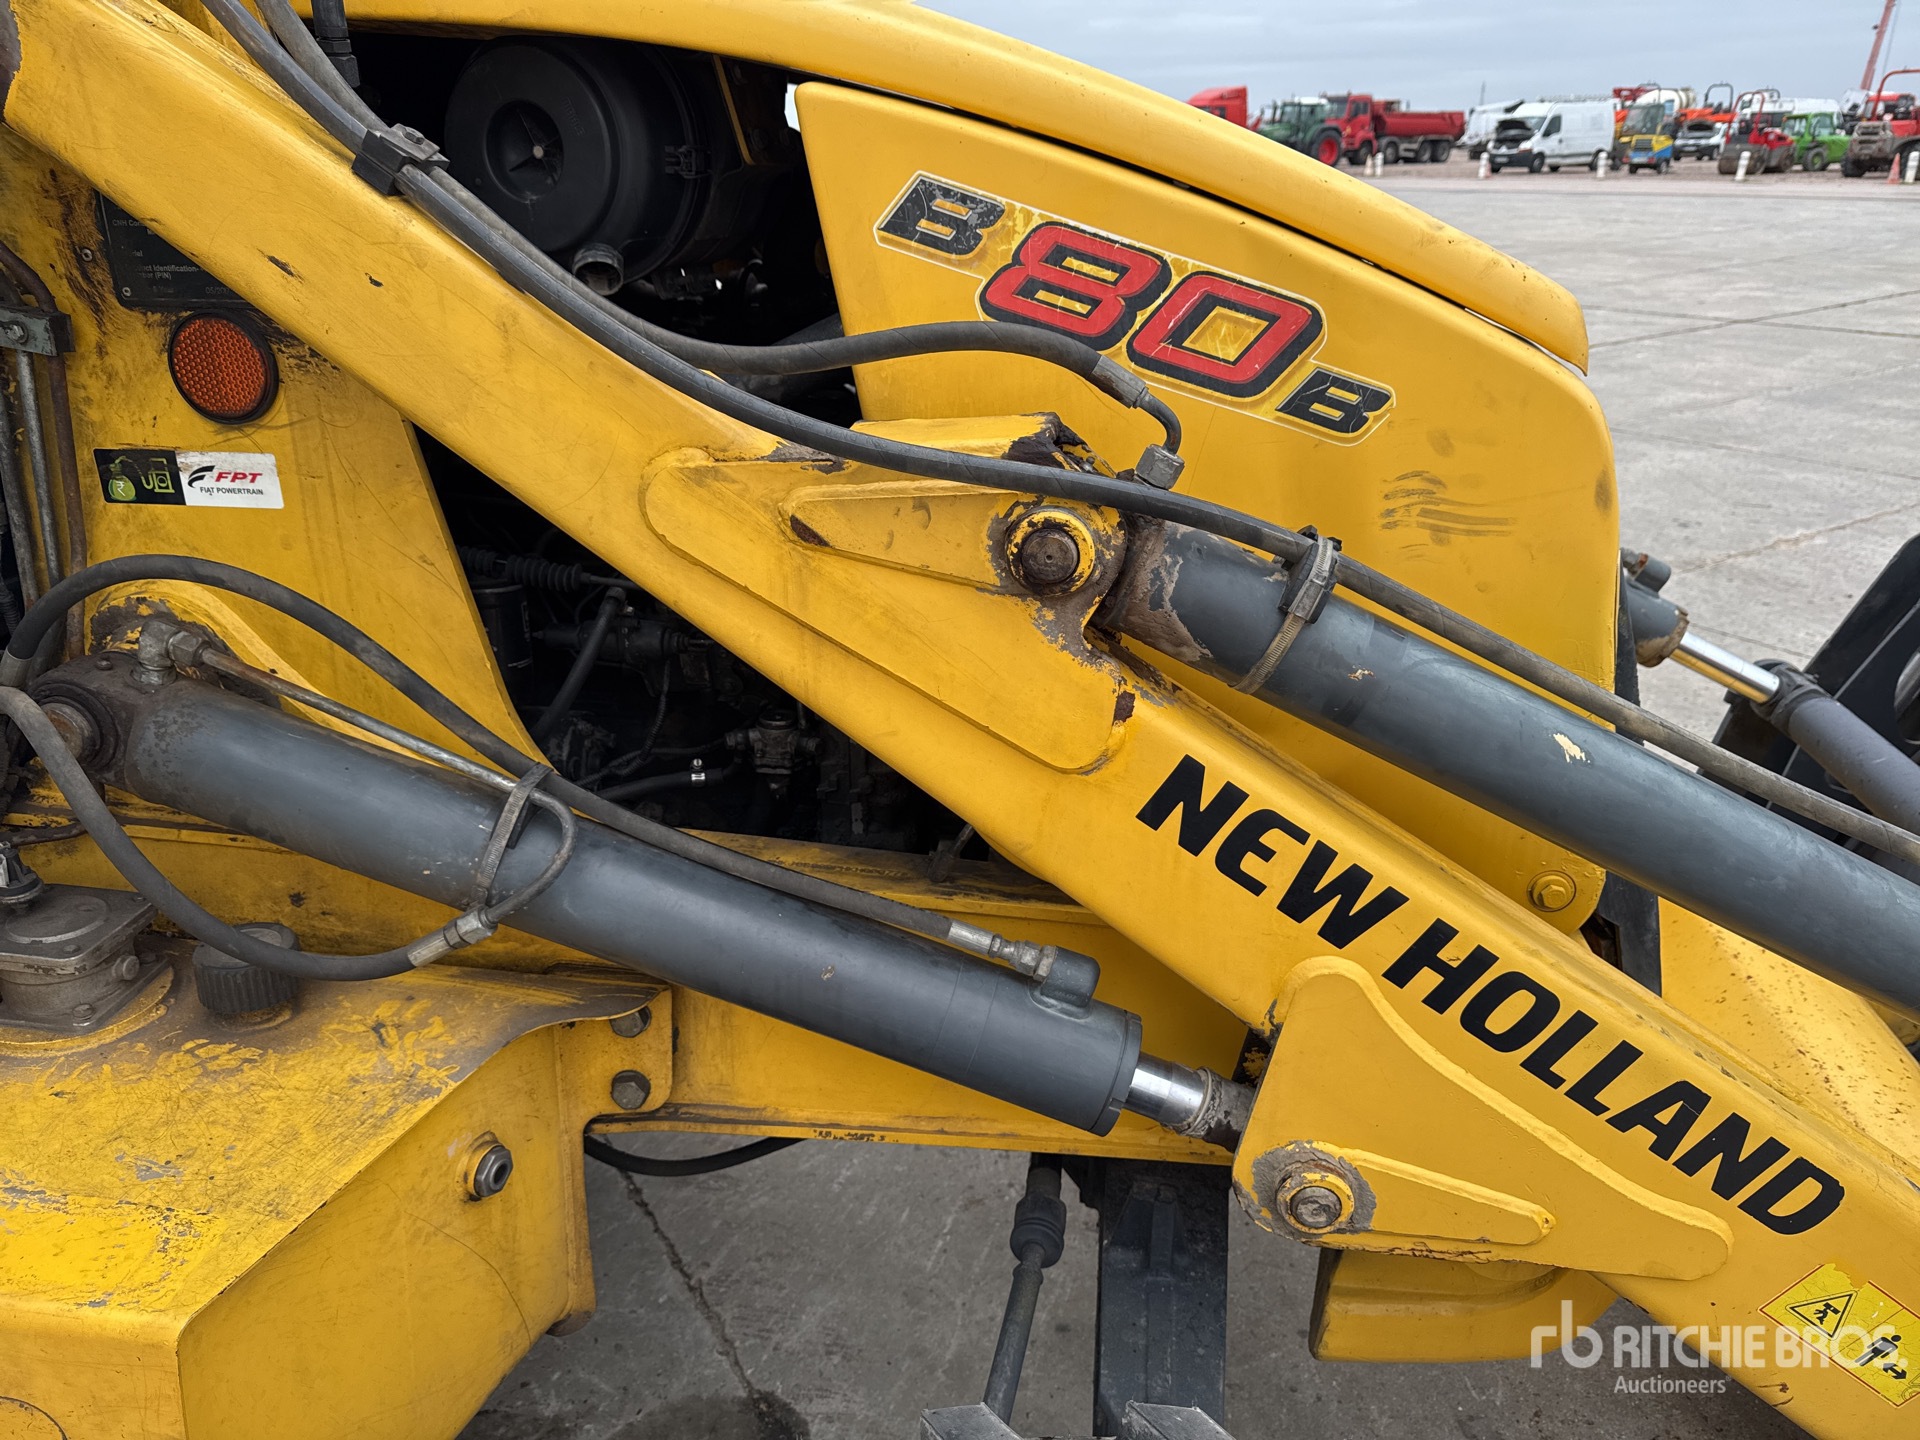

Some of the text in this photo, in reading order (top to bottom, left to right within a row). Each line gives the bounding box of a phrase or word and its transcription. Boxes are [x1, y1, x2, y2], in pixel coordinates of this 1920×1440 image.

[112, 219, 127, 227] CNH
[876, 175, 1393, 434] B 80 B
[214, 471, 263, 484] FPT
[200, 486, 264, 496] FIAT POWERTRAIN
[1136, 754, 1844, 1237] NEW HOLLAND
